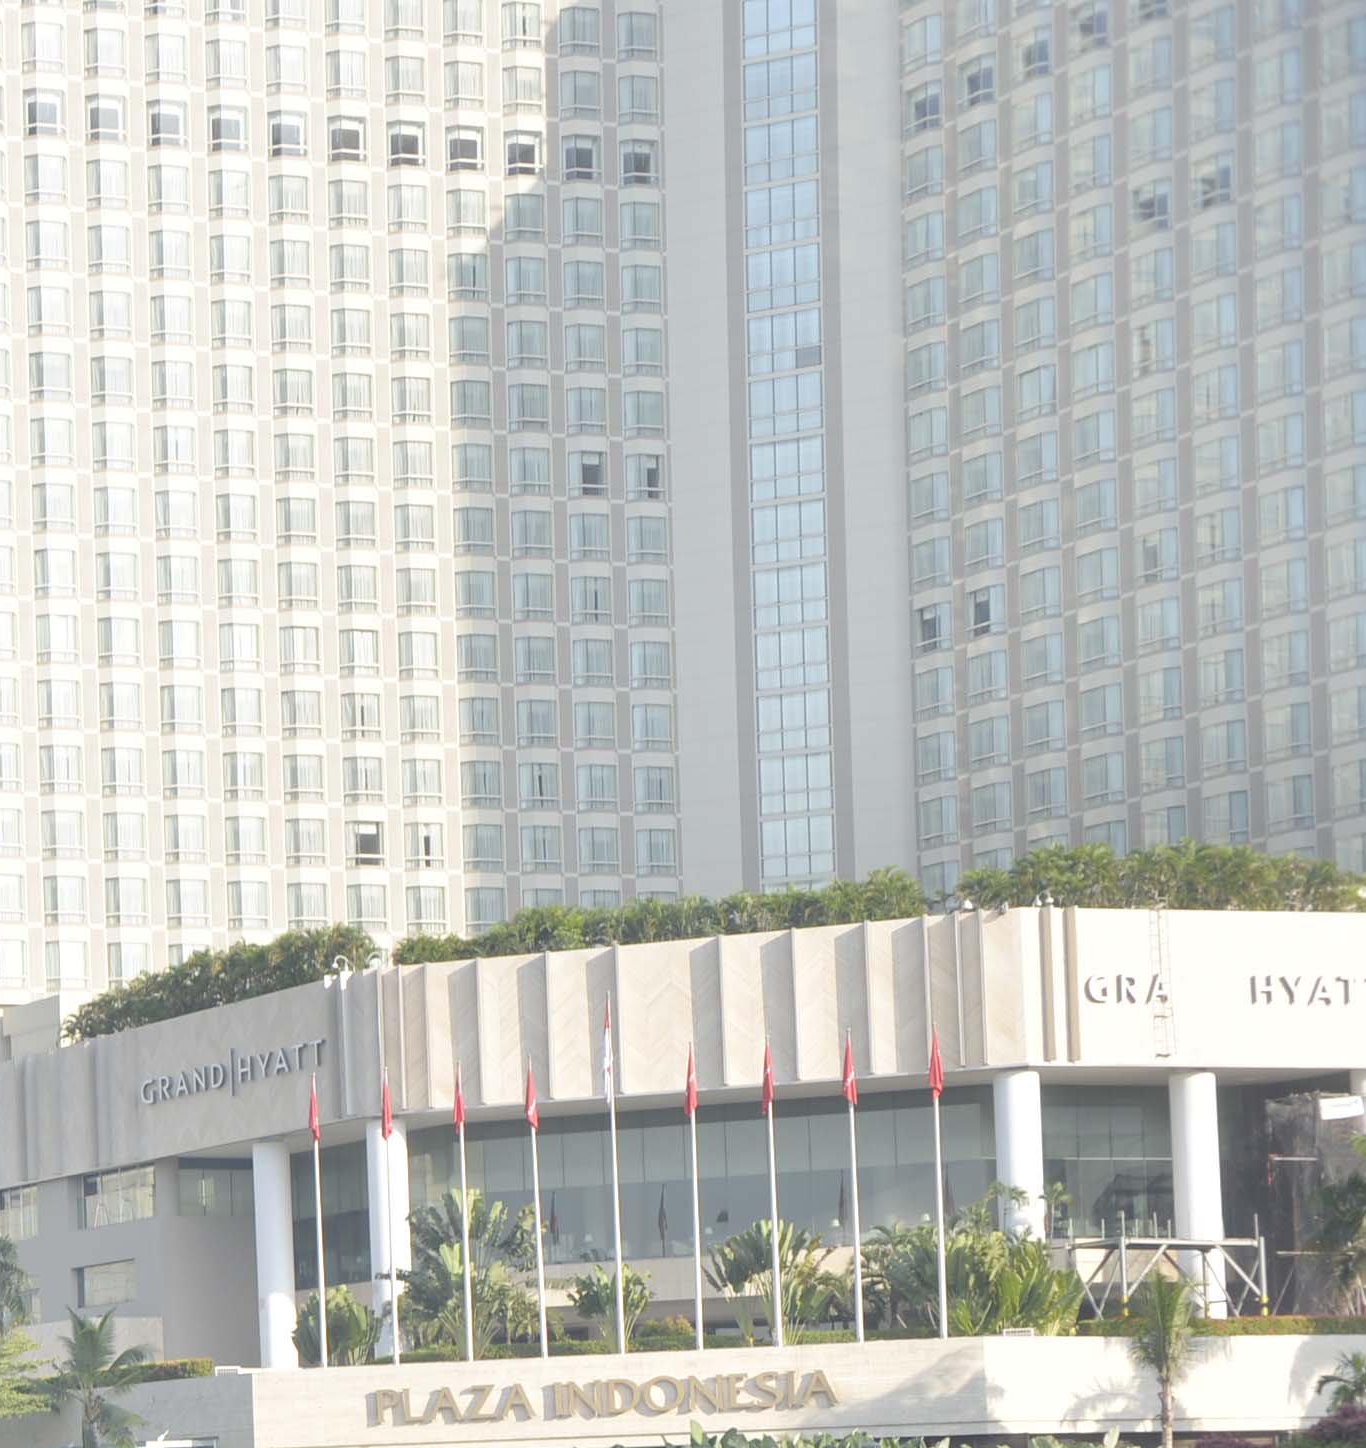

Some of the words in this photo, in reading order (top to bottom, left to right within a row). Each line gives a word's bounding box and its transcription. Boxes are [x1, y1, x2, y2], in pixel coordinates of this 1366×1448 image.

[1083, 973, 1169, 1004] GRA
[1250, 975, 1366, 1006] HYAT
[140, 1062, 228, 1105] GRAND
[238, 1039, 326, 1084] HYATT
[368, 1382, 536, 1427] PLAZA
[546, 1368, 840, 1421] INDONESIA
